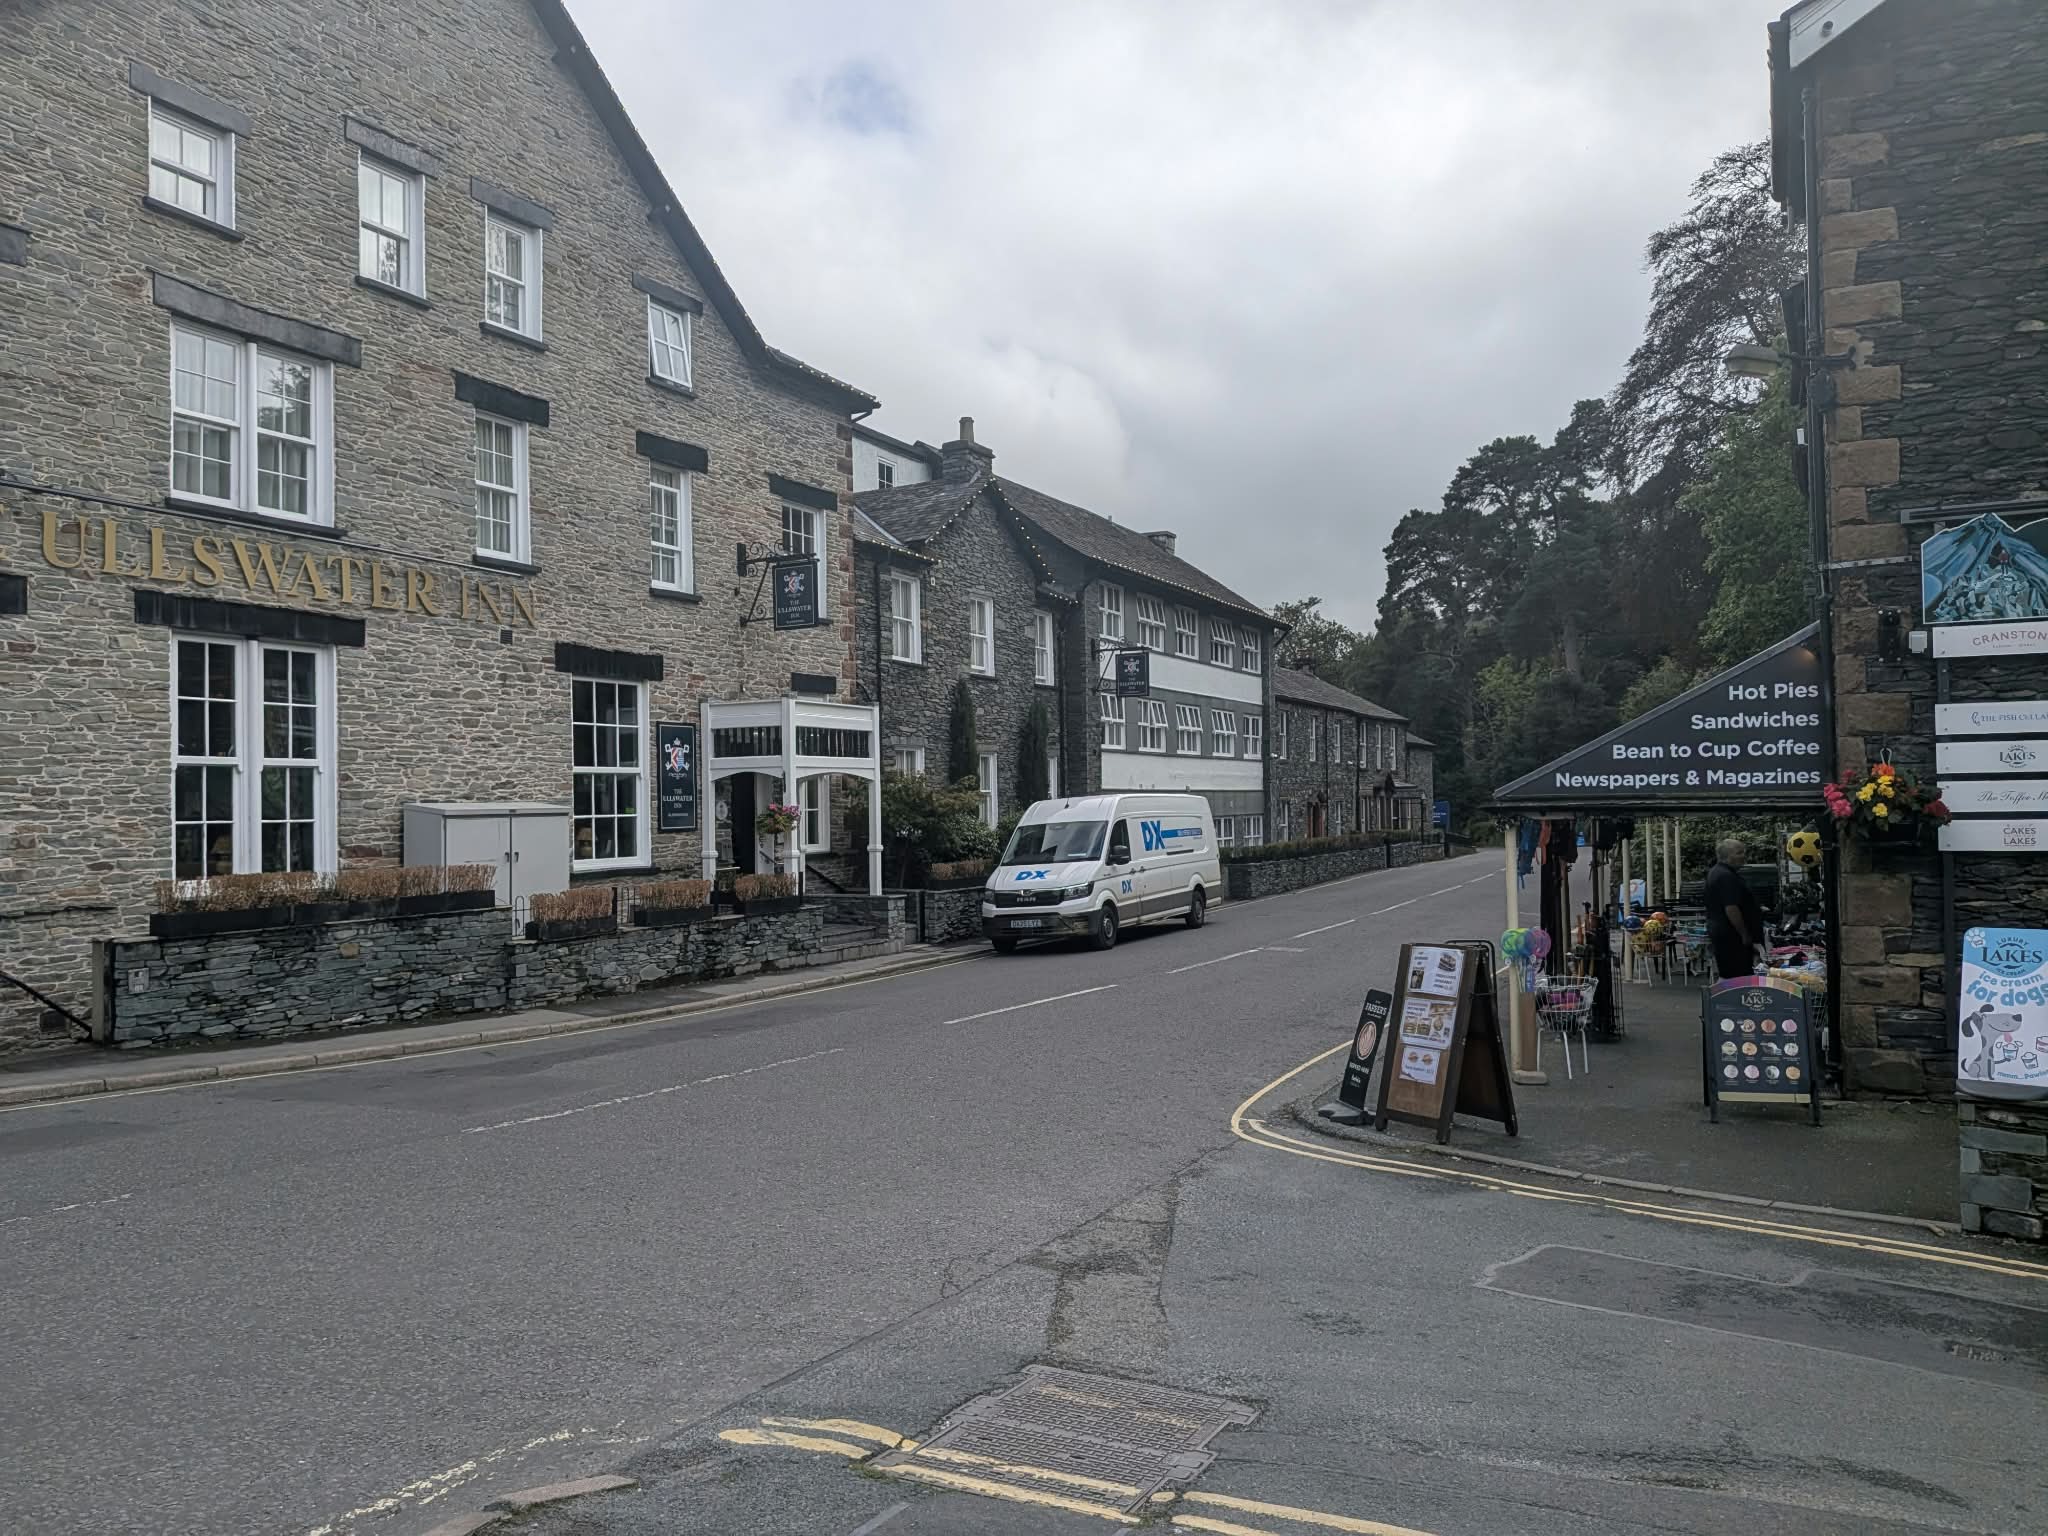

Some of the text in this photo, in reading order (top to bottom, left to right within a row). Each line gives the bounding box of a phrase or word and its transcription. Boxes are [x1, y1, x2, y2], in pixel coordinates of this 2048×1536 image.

[42, 511, 441, 615] ULLSWATER
[461, 577, 538, 628] INN
[1728, 682, 1819, 701] Hot Pies
[1690, 711, 1820, 730] Sandwiches
[1612, 740, 1820, 760] Bean to Cup Coffee
[1999, 751, 2037, 763] LAKES
[1555, 768, 1821, 790] Newspapers & Magazines
[1140, 820, 1166, 851] DX
[2003, 827, 2036, 835] CAKES
[2003, 837, 2037, 845] LAKES
[1015, 869, 1051, 881] DX
[1121, 878, 1133, 895] DX
[1982, 947, 2043, 966] LAKES
[1979, 971, 2044, 988] ice cream
[1741, 994, 1773, 1006] LAKES
[1966, 980, 2048, 1007] for dogs
